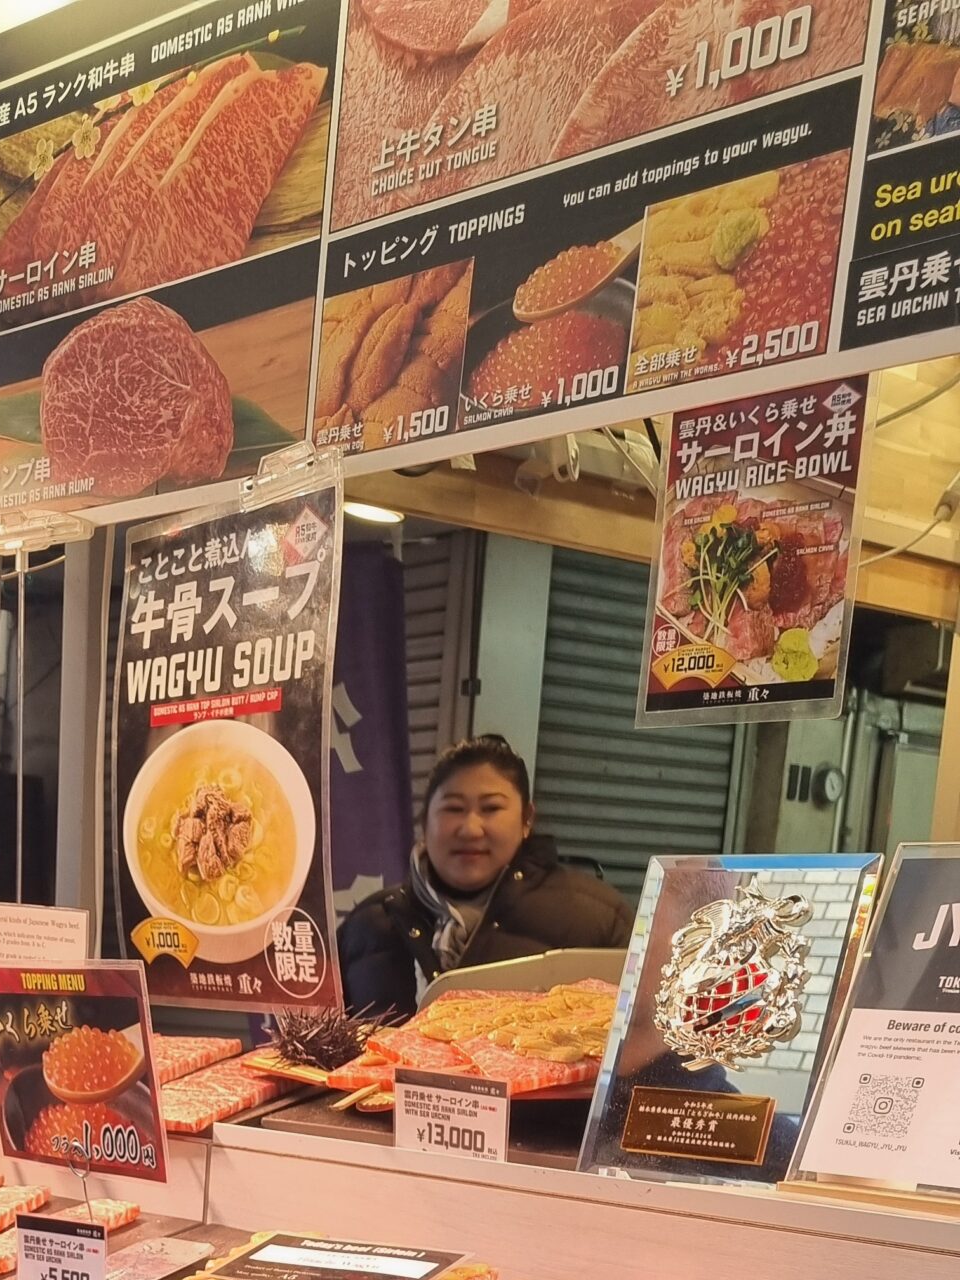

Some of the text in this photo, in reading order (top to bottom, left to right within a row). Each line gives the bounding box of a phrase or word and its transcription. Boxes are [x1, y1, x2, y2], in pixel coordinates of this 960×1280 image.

[151, 22, 213, 64] DOMESTIC
[216, 14, 234, 38] A5
[237, 1, 271, 28] RANK
[665, 5, 812, 97] ¥1,000
[14, 93, 38, 121] A5
[42, 52, 136, 111] ランク和牛串
[372, 104, 497, 172] 上牛タン串
[372, 141, 497, 197] CHOICE CUT TONGUE
[588, 182, 611, 201] can
[614, 171, 638, 193] add
[642, 155, 700, 185] toppings
[704, 149, 719, 165] to
[722, 138, 757, 164] your
[762, 122, 813, 149] Wagyu.
[874, 181, 922, 208] Sea
[449, 204, 526, 244] TOPPINGS
[870, 218, 902, 241] on
[343, 224, 439, 278] トッピング
[38, 286, 49, 302] A5
[52, 277, 76, 298] RANK
[78, 266, 114, 290] SIRLOIN
[856, 304, 887, 327] SEA
[891, 290, 949, 319] URCHIN
[634, 320, 819, 377] 全部乗せ ¥2,500
[464, 365, 619, 412] いくら乗せ ¥1,000
[663, 371, 679, 384] WITH
[316, 421, 364, 446] 雲丹乗せ
[383, 405, 449, 446] ¥1,500
[464, 410, 491, 425] SALMON
[679, 395, 817, 440] 雲丹&いくら乗せ
[677, 411, 857, 474] サーロイン丼
[29, 487, 40, 503] A5
[43, 481, 67, 500] RANK
[69, 476, 95, 496] RUMP
[675, 449, 852, 500] WAGYU RICE BOWL
[139, 528, 276, 584] ことこと煮込
[130, 546, 327, 649] 牛骨スープ
[127, 629, 316, 705] WAGYU SOUP
[663, 654, 715, 673] ¥12,000
[144, 931, 180, 950] ¥1,000
[271, 921, 315, 953] 数量
[21, 972, 86, 992] TOPPING MENU
[274, 952, 319, 984] 限定
[887, 1019, 931, 1032] Beware
[933, 1021, 948, 1033] of
[404, 1099, 432, 1111] DOMESTIC
[435, 1094, 480, 1110] サーロイン串
[416, 1121, 486, 1154] ¥13,000
